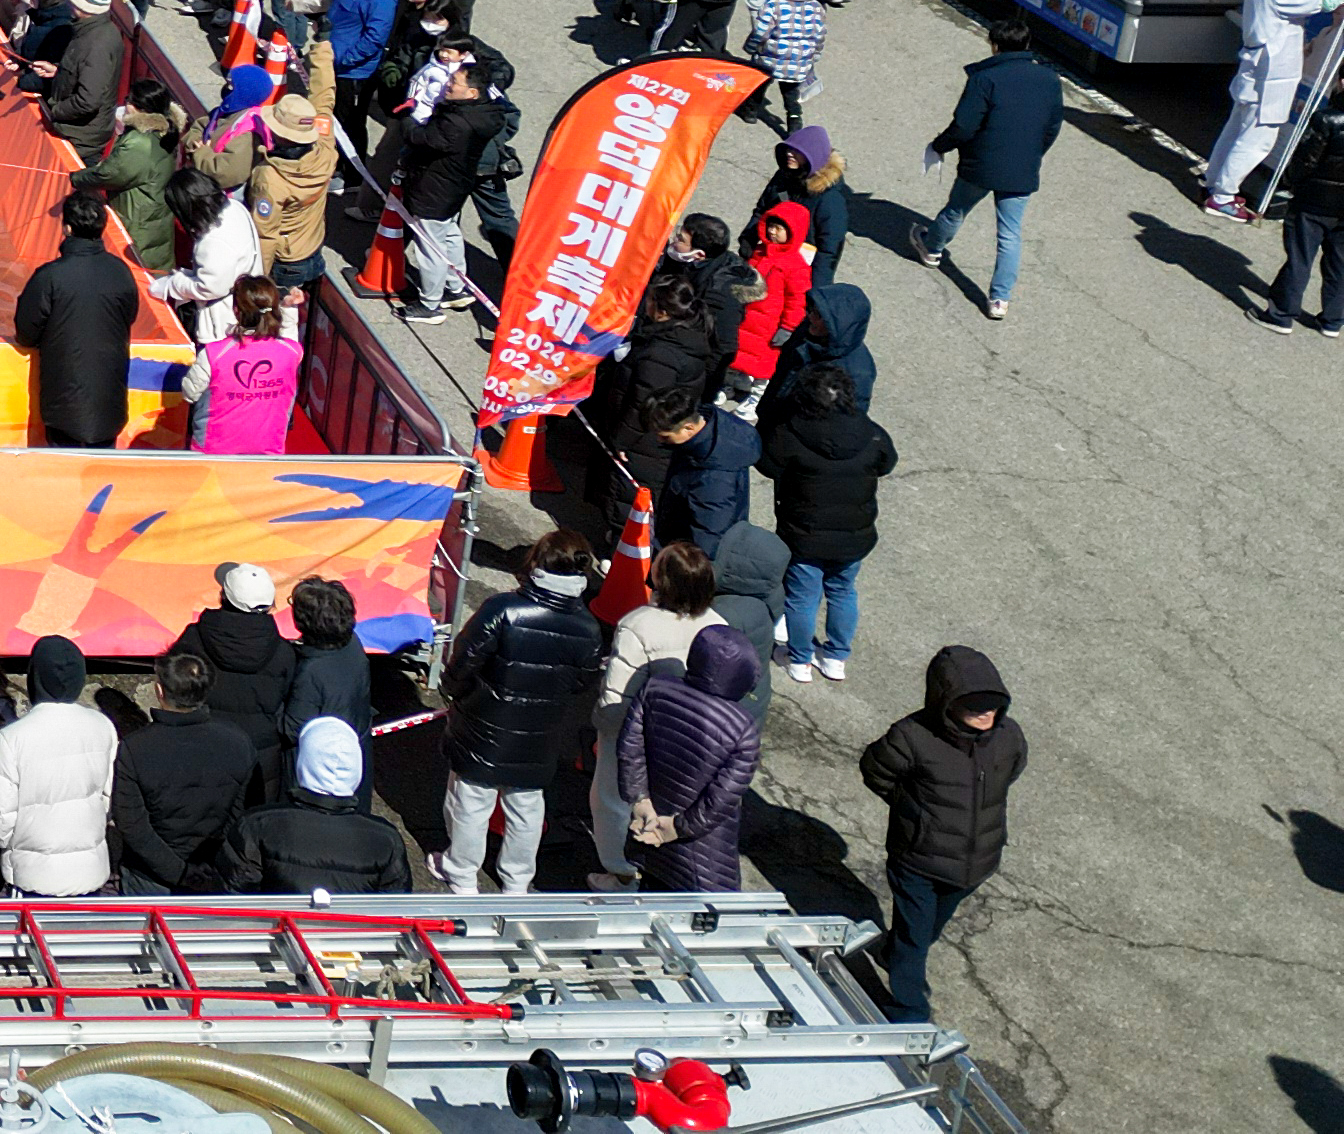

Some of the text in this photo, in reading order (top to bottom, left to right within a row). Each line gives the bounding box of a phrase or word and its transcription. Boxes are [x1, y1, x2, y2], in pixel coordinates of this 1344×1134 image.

[626, 73, 691, 106] 제27회
[525, 92, 680, 346] 영덕대게축제
[252, 377, 284, 389] 1365
